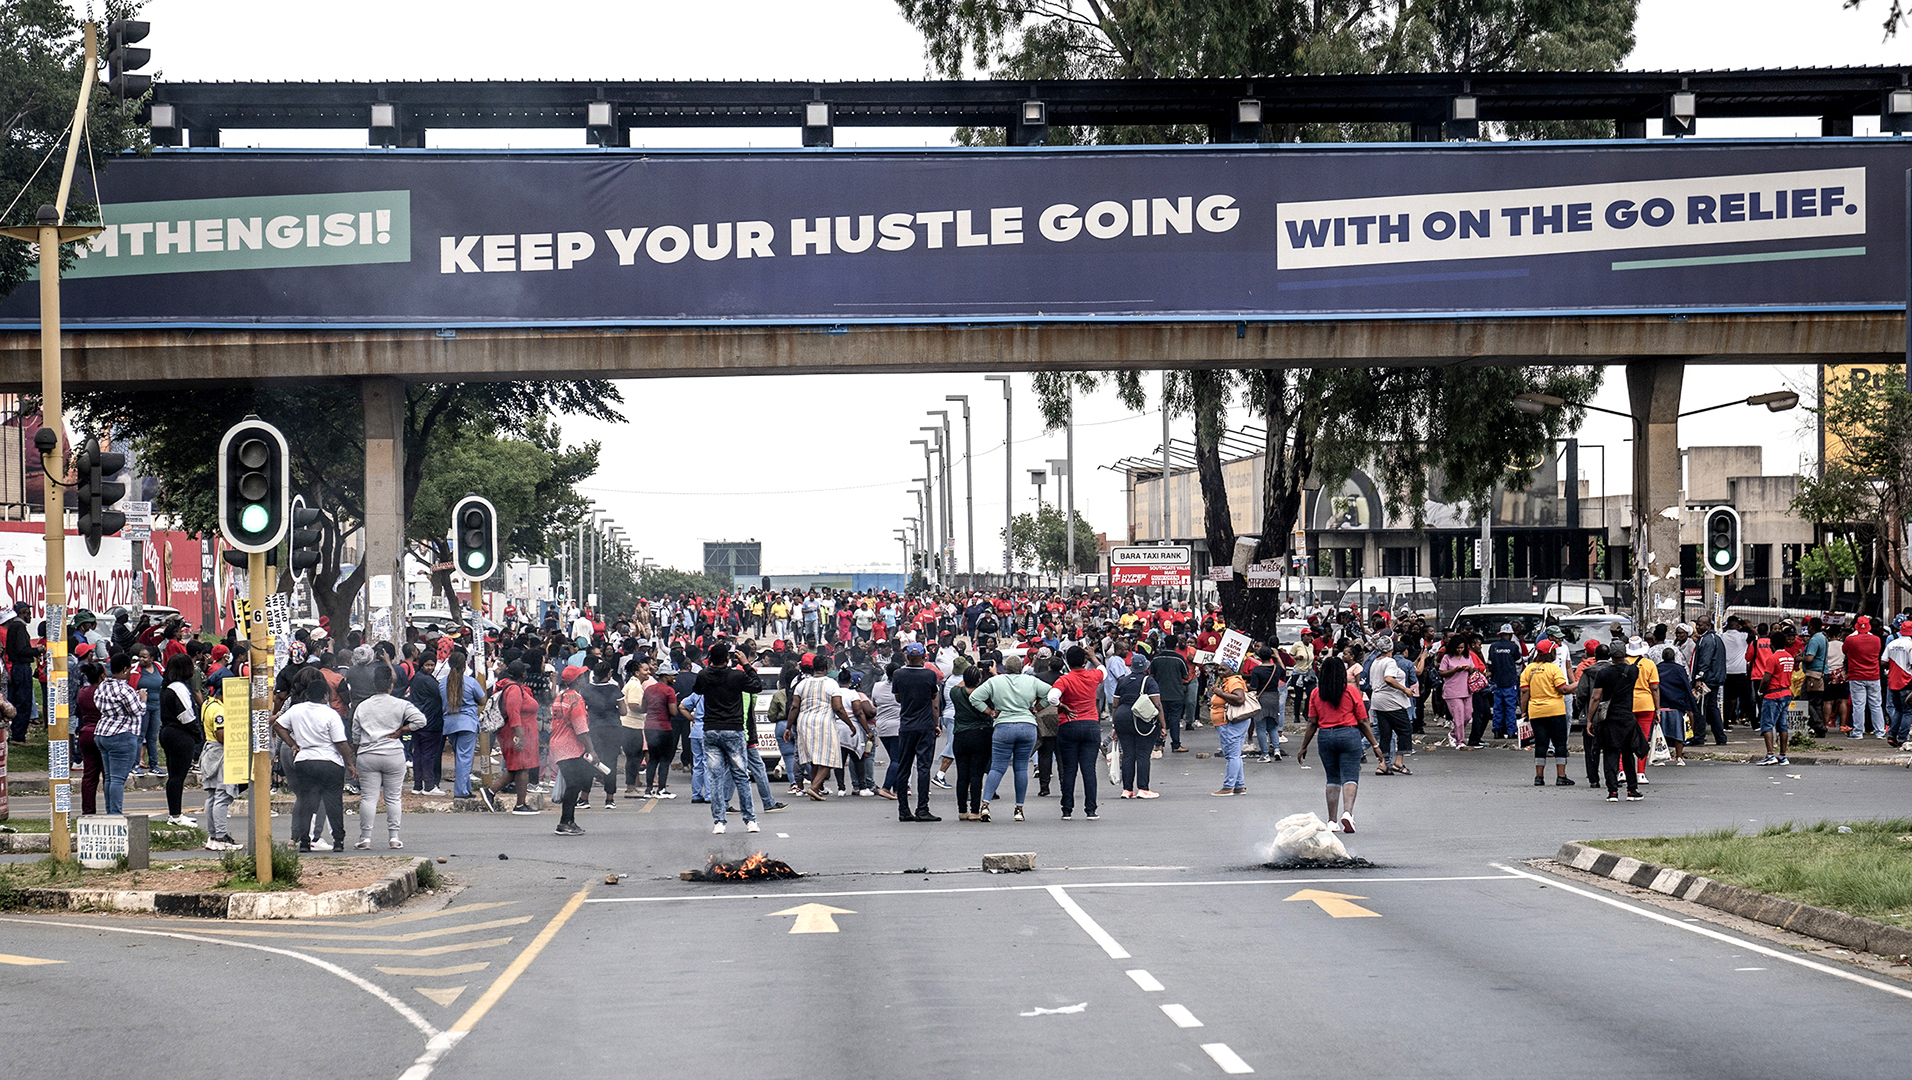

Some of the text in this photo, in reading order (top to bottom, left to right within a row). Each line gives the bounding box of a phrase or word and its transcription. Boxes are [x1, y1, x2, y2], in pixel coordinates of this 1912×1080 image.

[1285, 185, 1859, 250] WITH ON THE GO RELIEF.
[440, 194, 1240, 274] KEEP YOUR HUSTLE GOING
[1247, 564, 1281, 573] PLUMBER
[87, 570, 109, 614] May
[254, 610, 262, 622] 6
[266, 610, 274, 628] BED
[274, 609, 283, 635] GREAT
